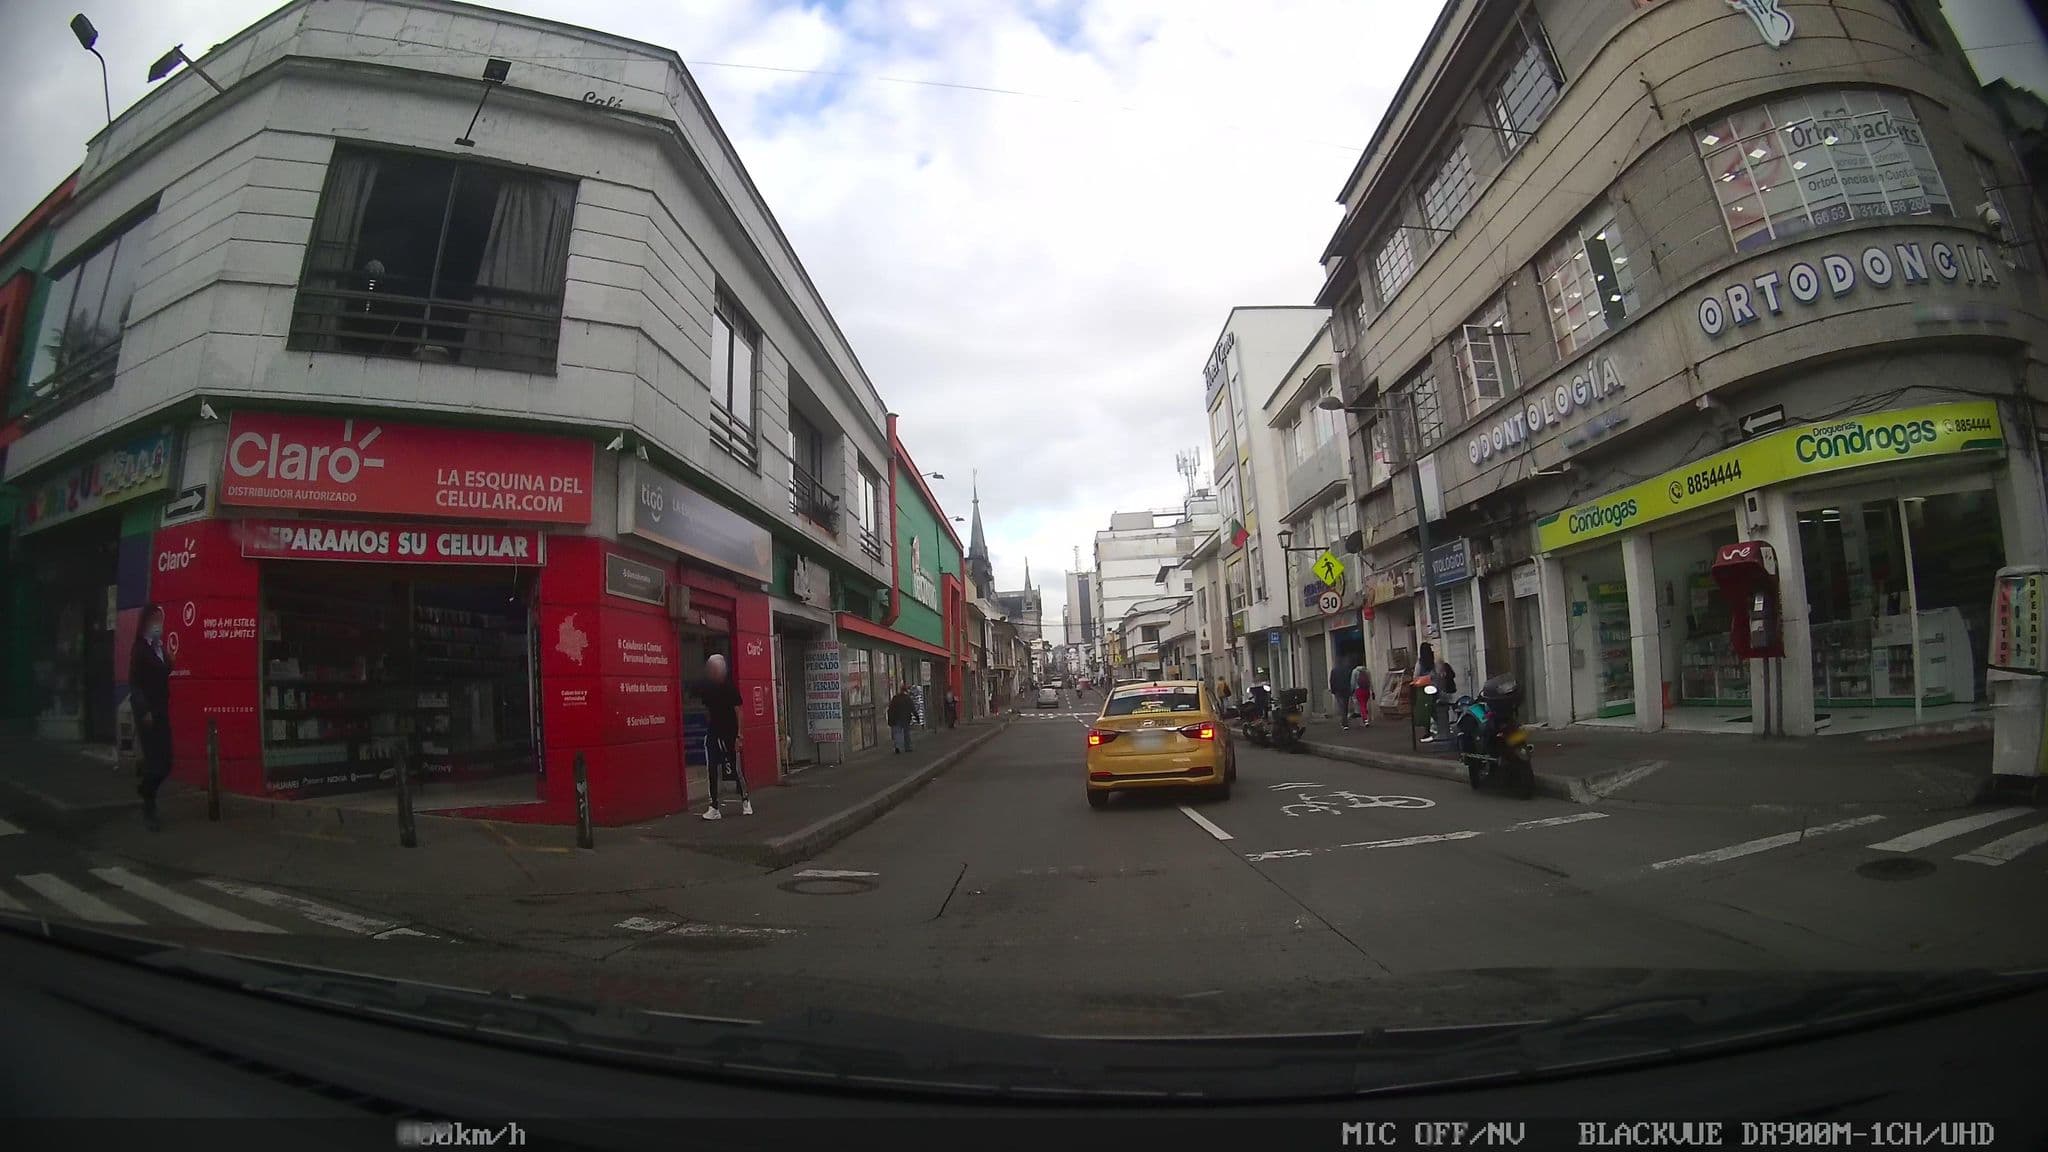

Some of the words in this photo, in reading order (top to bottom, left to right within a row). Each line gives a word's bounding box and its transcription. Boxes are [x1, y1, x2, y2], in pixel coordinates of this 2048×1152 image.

[1698, 242, 2000, 336] ORTODONCIA
[1469, 355, 1625, 465] ODONTOLOGÍA
[229, 428, 364, 484] Claro
[1796, 419, 1937, 463] Condrogas
[437, 468, 460, 486] LA
[465, 470, 544, 492] ESQUINA
[550, 477, 583, 494] DEL
[1687, 459, 1742, 494] 8854444
[227, 486, 293, 499] DISTRIBUIDOR
[295, 490, 357, 502] AUTORIZADO
[436, 490, 563, 512] CELULAR.COM
[1568, 498, 1638, 535] Condrogas
[158, 548, 191, 572] Claro
[397, 531, 427, 555] SU
[436, 533, 528, 558] CELULAR
[1322, 597, 1338, 609] 30
